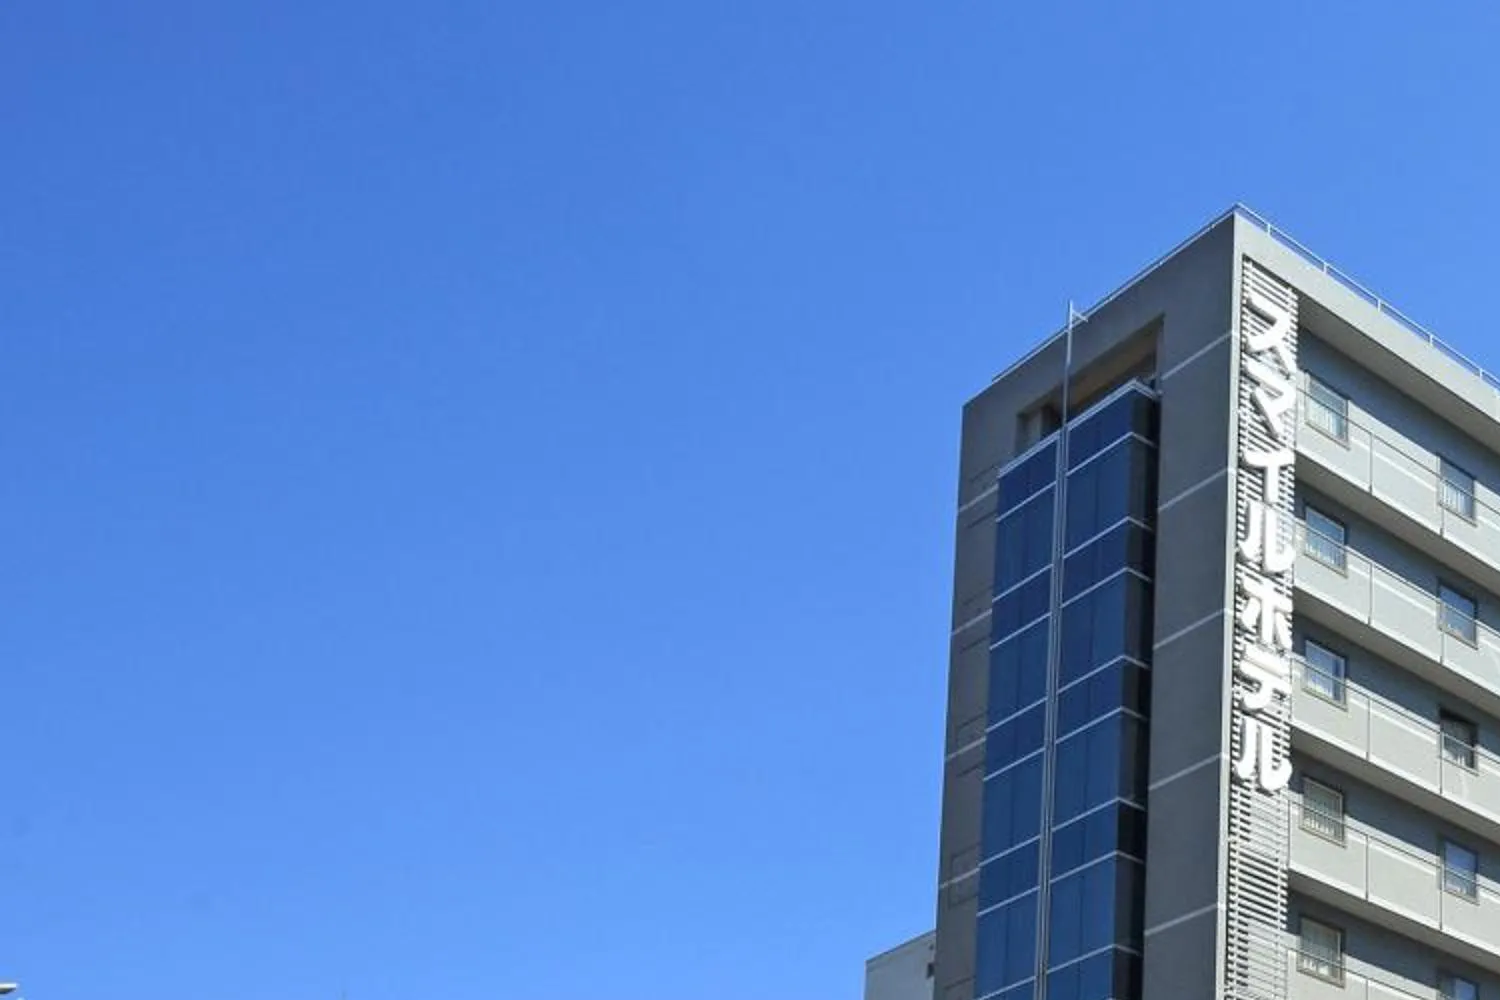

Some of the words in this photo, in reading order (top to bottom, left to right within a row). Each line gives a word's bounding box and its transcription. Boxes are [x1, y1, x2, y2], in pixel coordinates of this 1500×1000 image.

[1236, 293, 1296, 791] スマイルホテル
